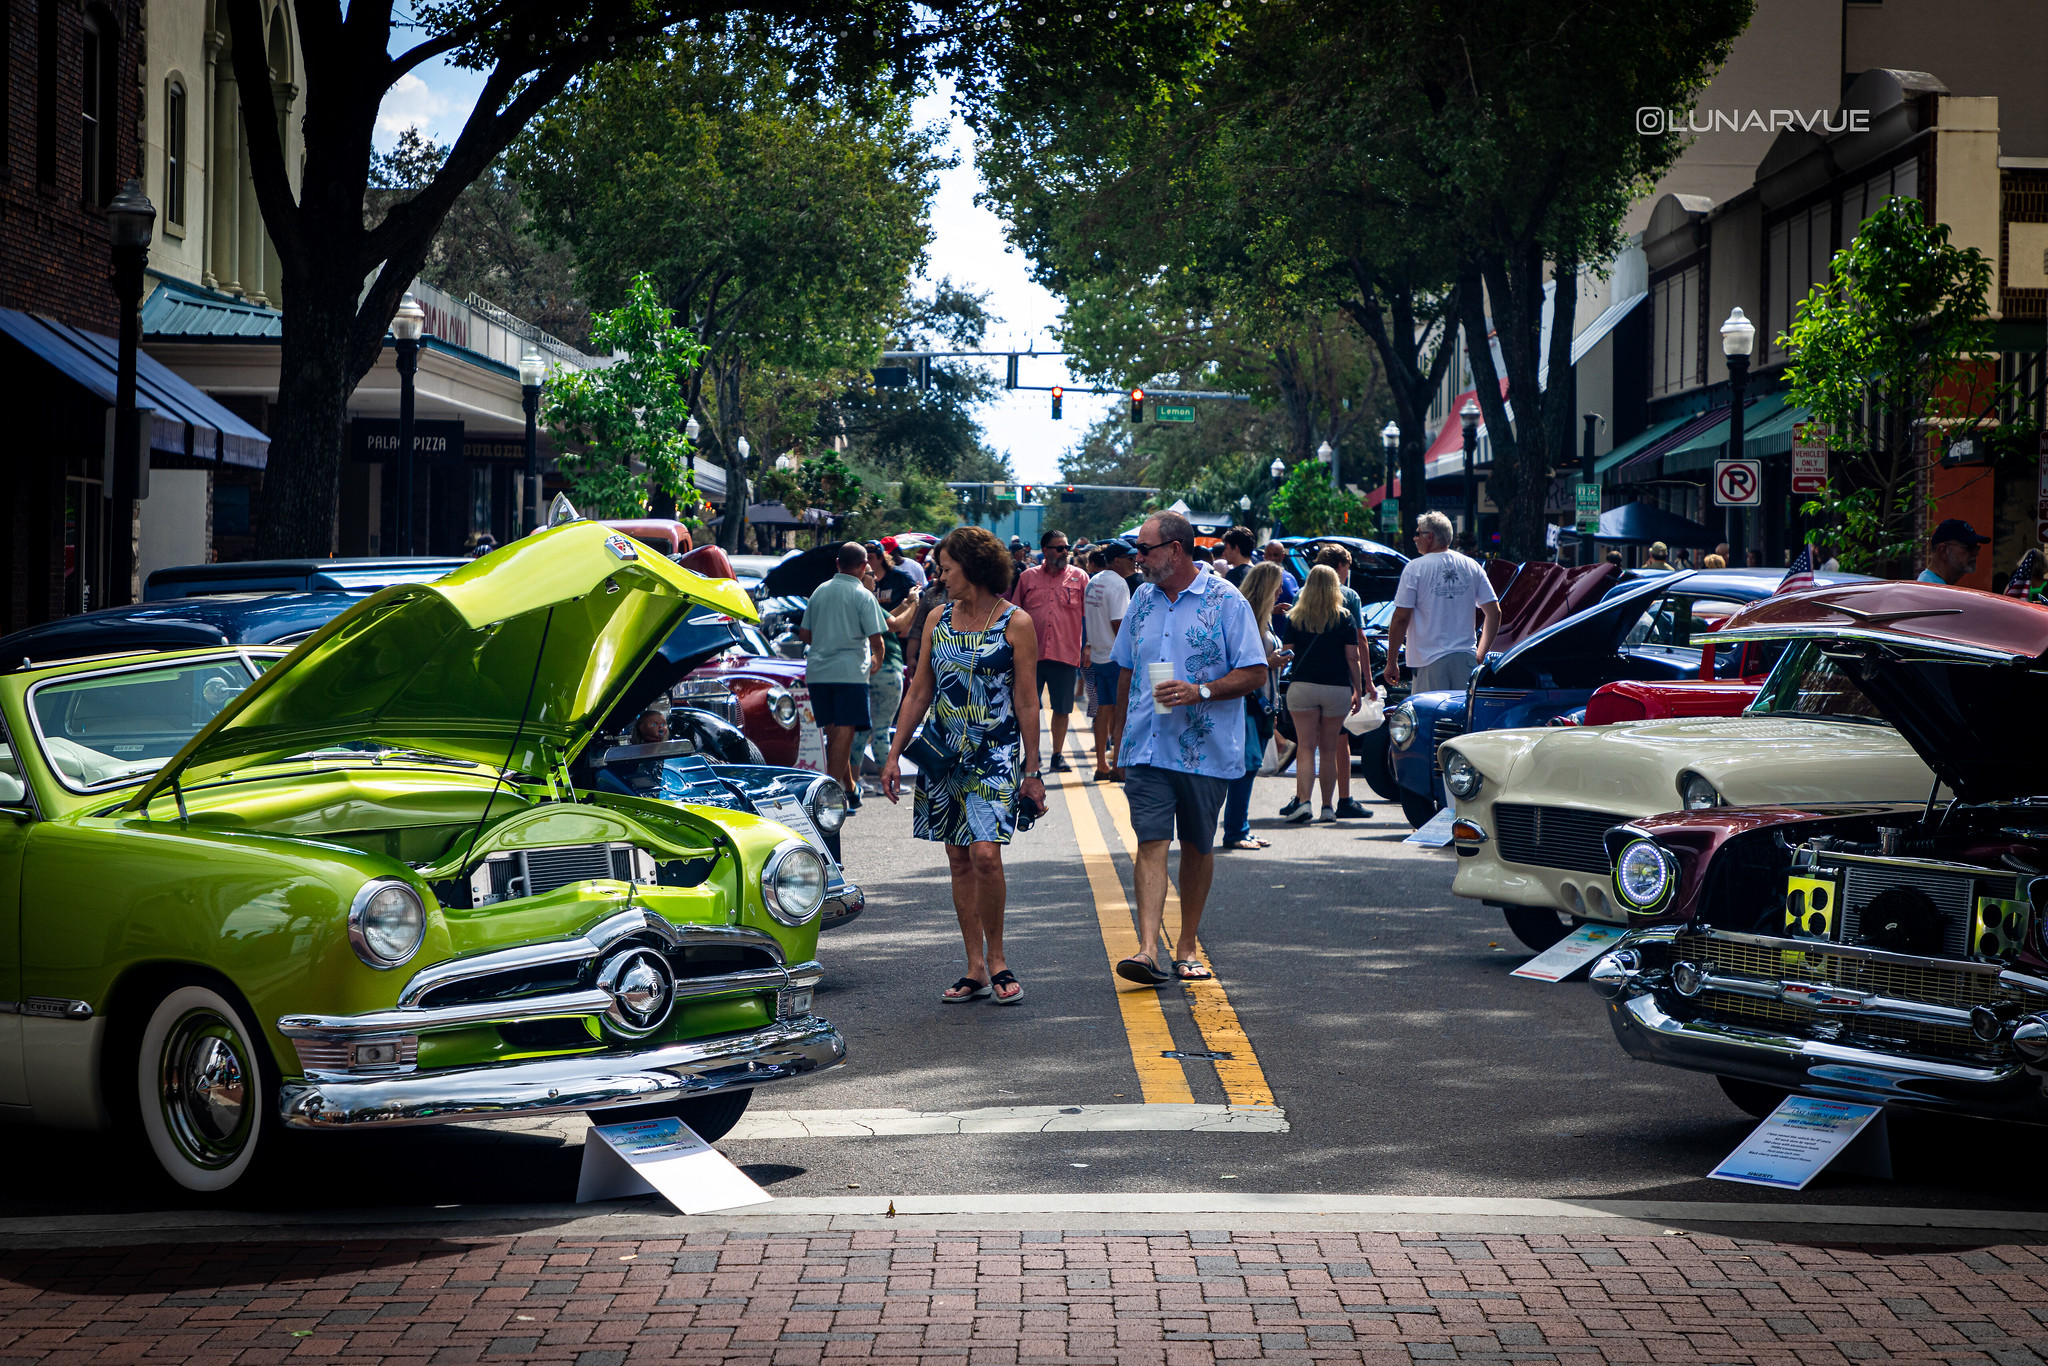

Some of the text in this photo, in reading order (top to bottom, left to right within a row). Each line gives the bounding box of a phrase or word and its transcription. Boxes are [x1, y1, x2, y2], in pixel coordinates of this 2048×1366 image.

[1160, 406, 1190, 415] Lemon
[367, 434, 447, 452] PALA PIZZA
[1801, 459, 1819, 467] ONLY
